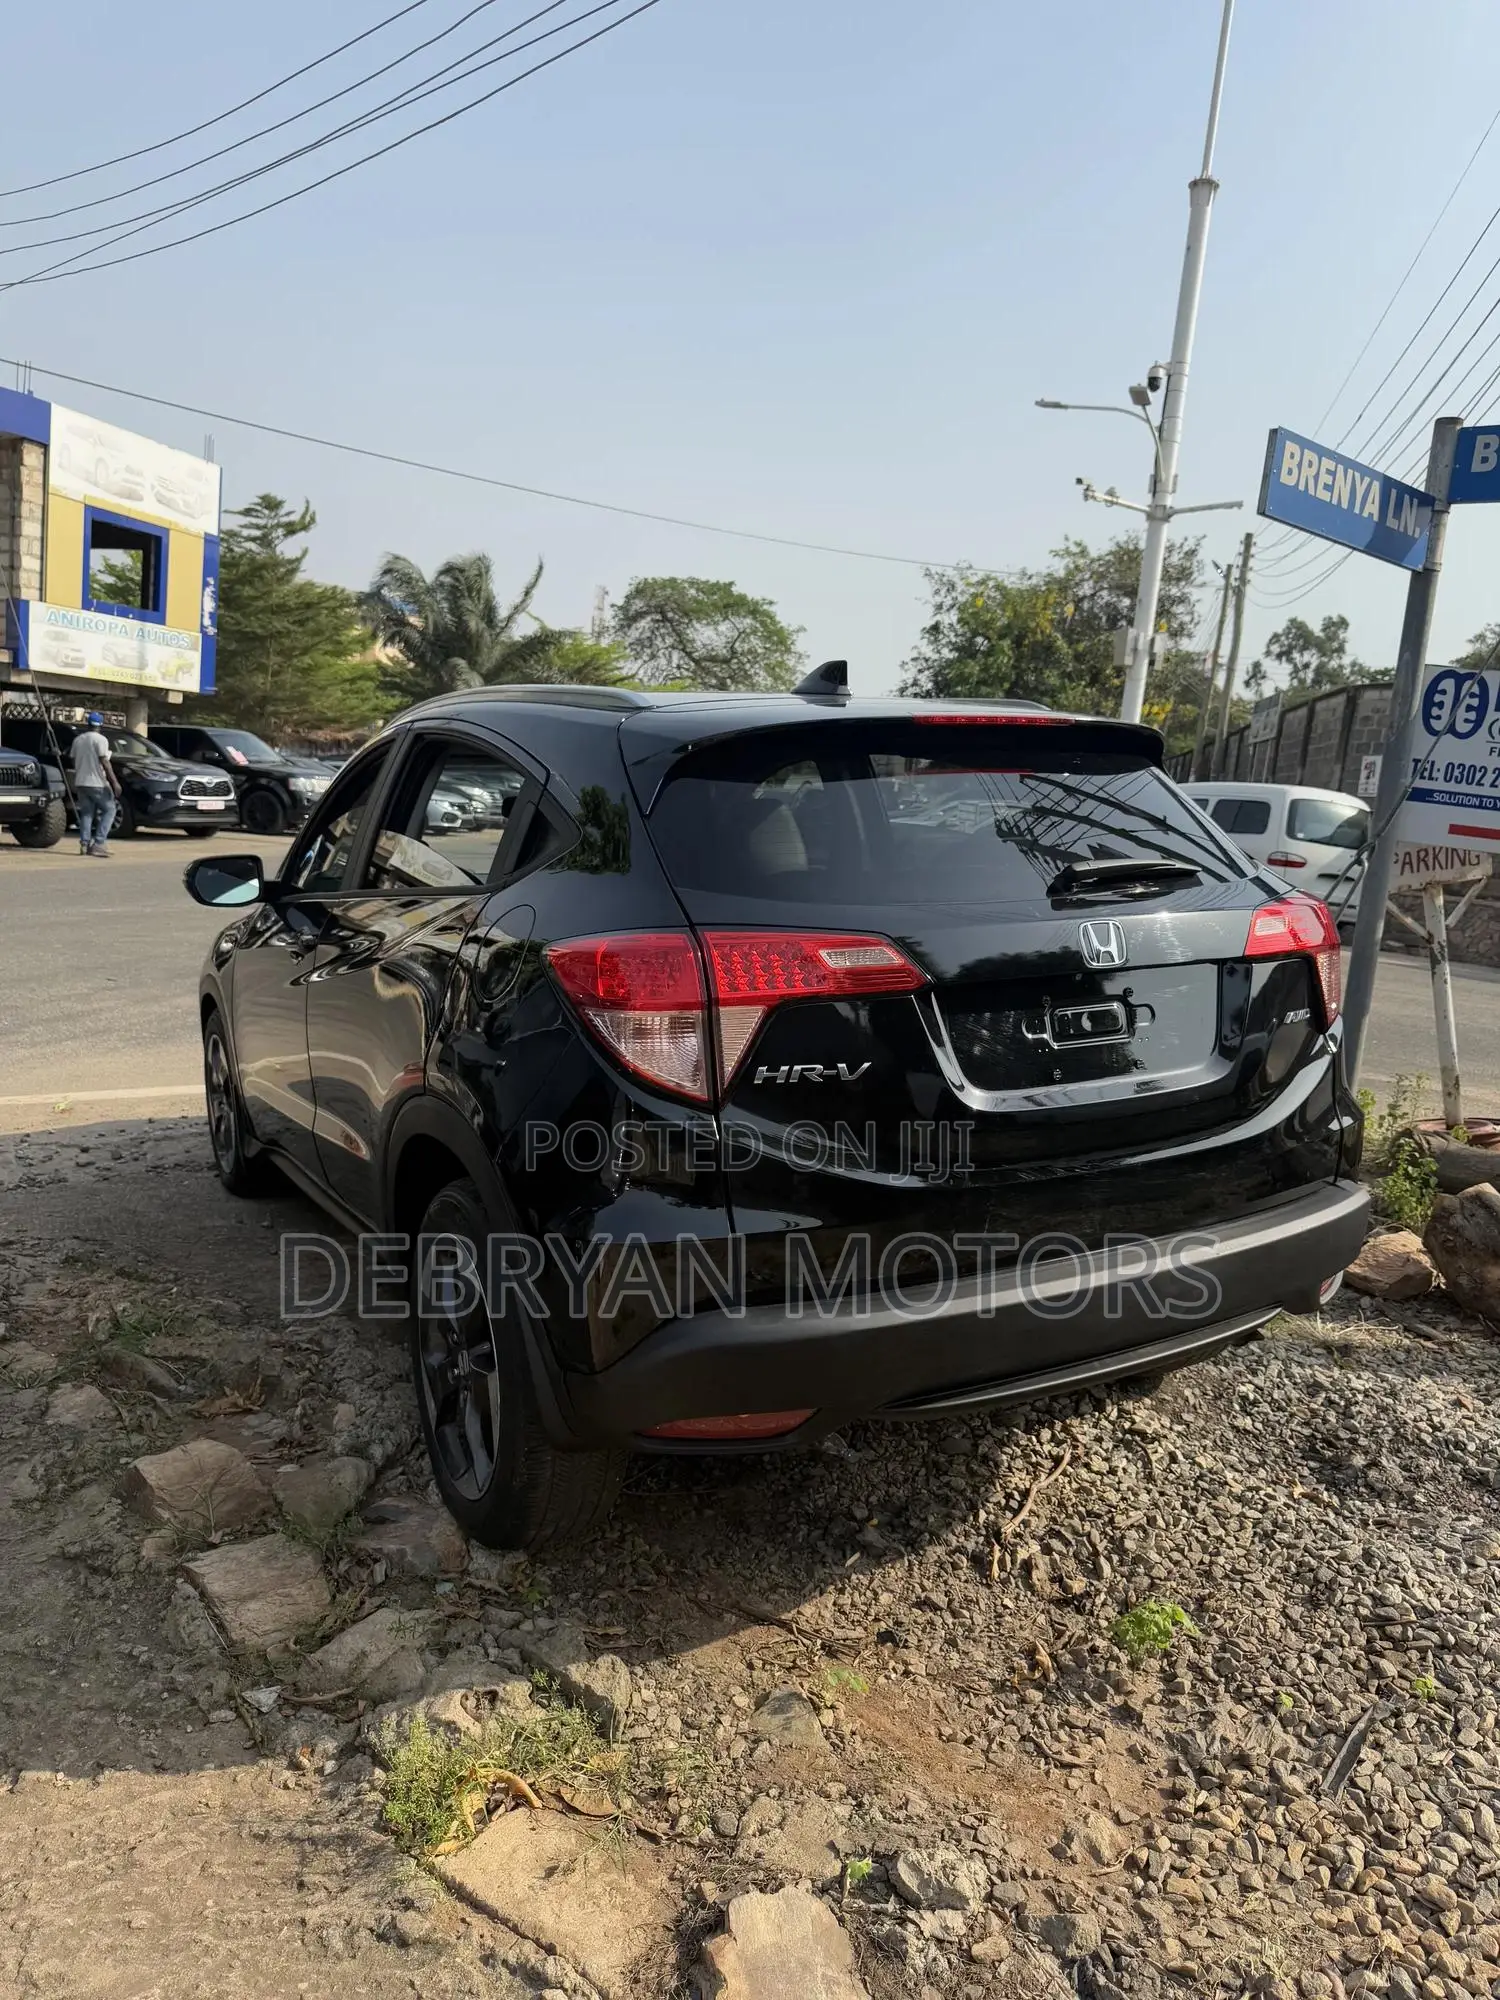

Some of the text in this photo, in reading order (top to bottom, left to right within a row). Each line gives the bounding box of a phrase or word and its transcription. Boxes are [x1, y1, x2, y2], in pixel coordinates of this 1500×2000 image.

[1279, 440, 1421, 538] BRENYA LN.
[47, 608, 192, 648] ANIROPA AUTOS
[1411, 758, 1440, 782] TEL:
[1443, 762, 1488, 787] 0302
[1481, 797, 1494, 808] TO
[754, 1061, 872, 1084] HR-V
